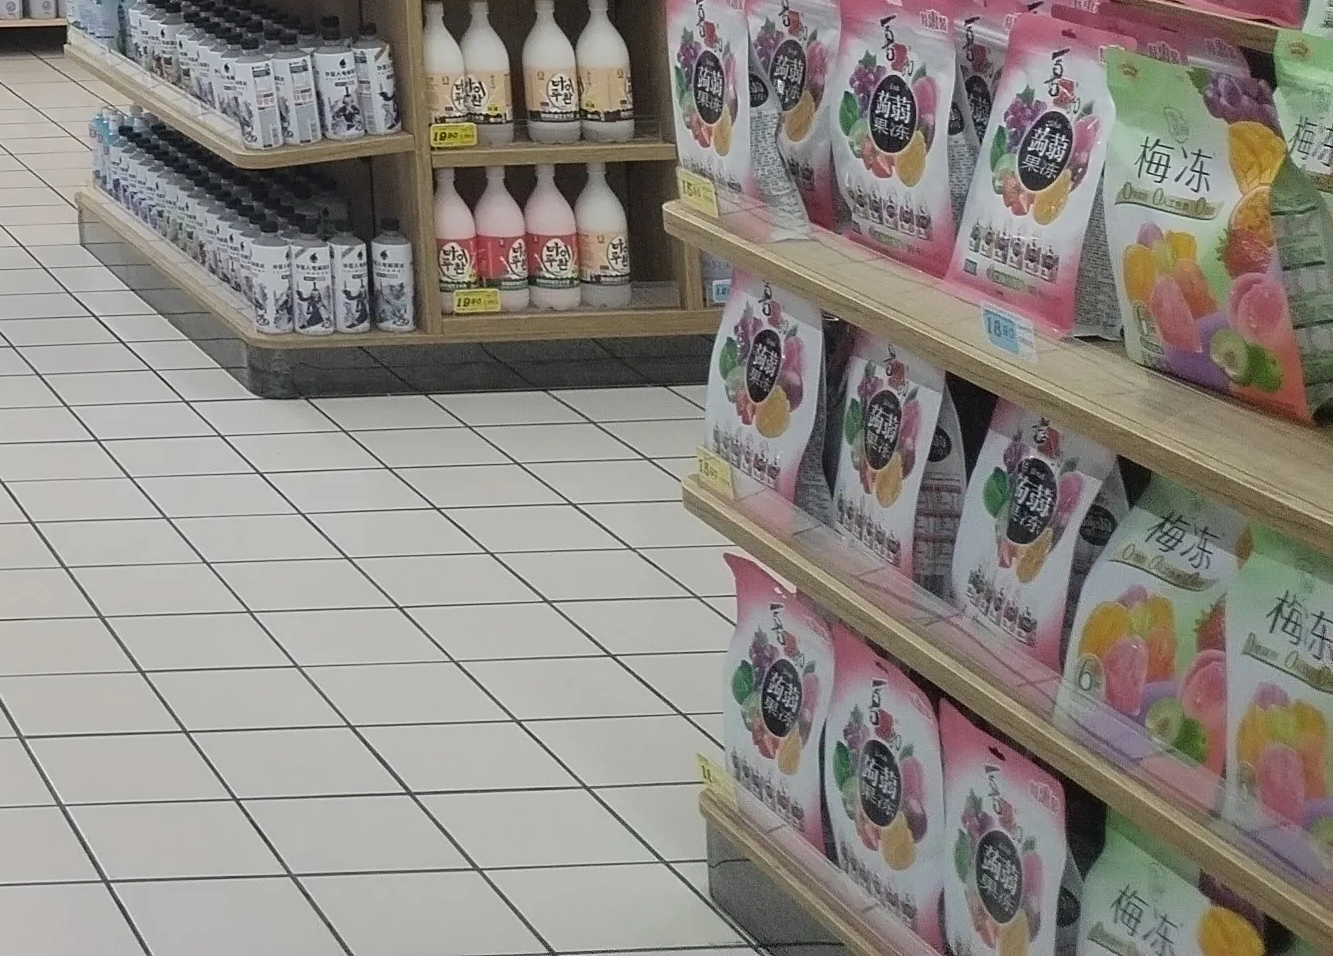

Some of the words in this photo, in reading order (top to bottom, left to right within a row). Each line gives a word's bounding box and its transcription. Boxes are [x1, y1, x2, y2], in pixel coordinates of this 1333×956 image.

[874, 97, 911, 125] 蒟蒻
[1031, 125, 1070, 161] 蒟蒻
[1134, 136, 1213, 194] 梅冻
